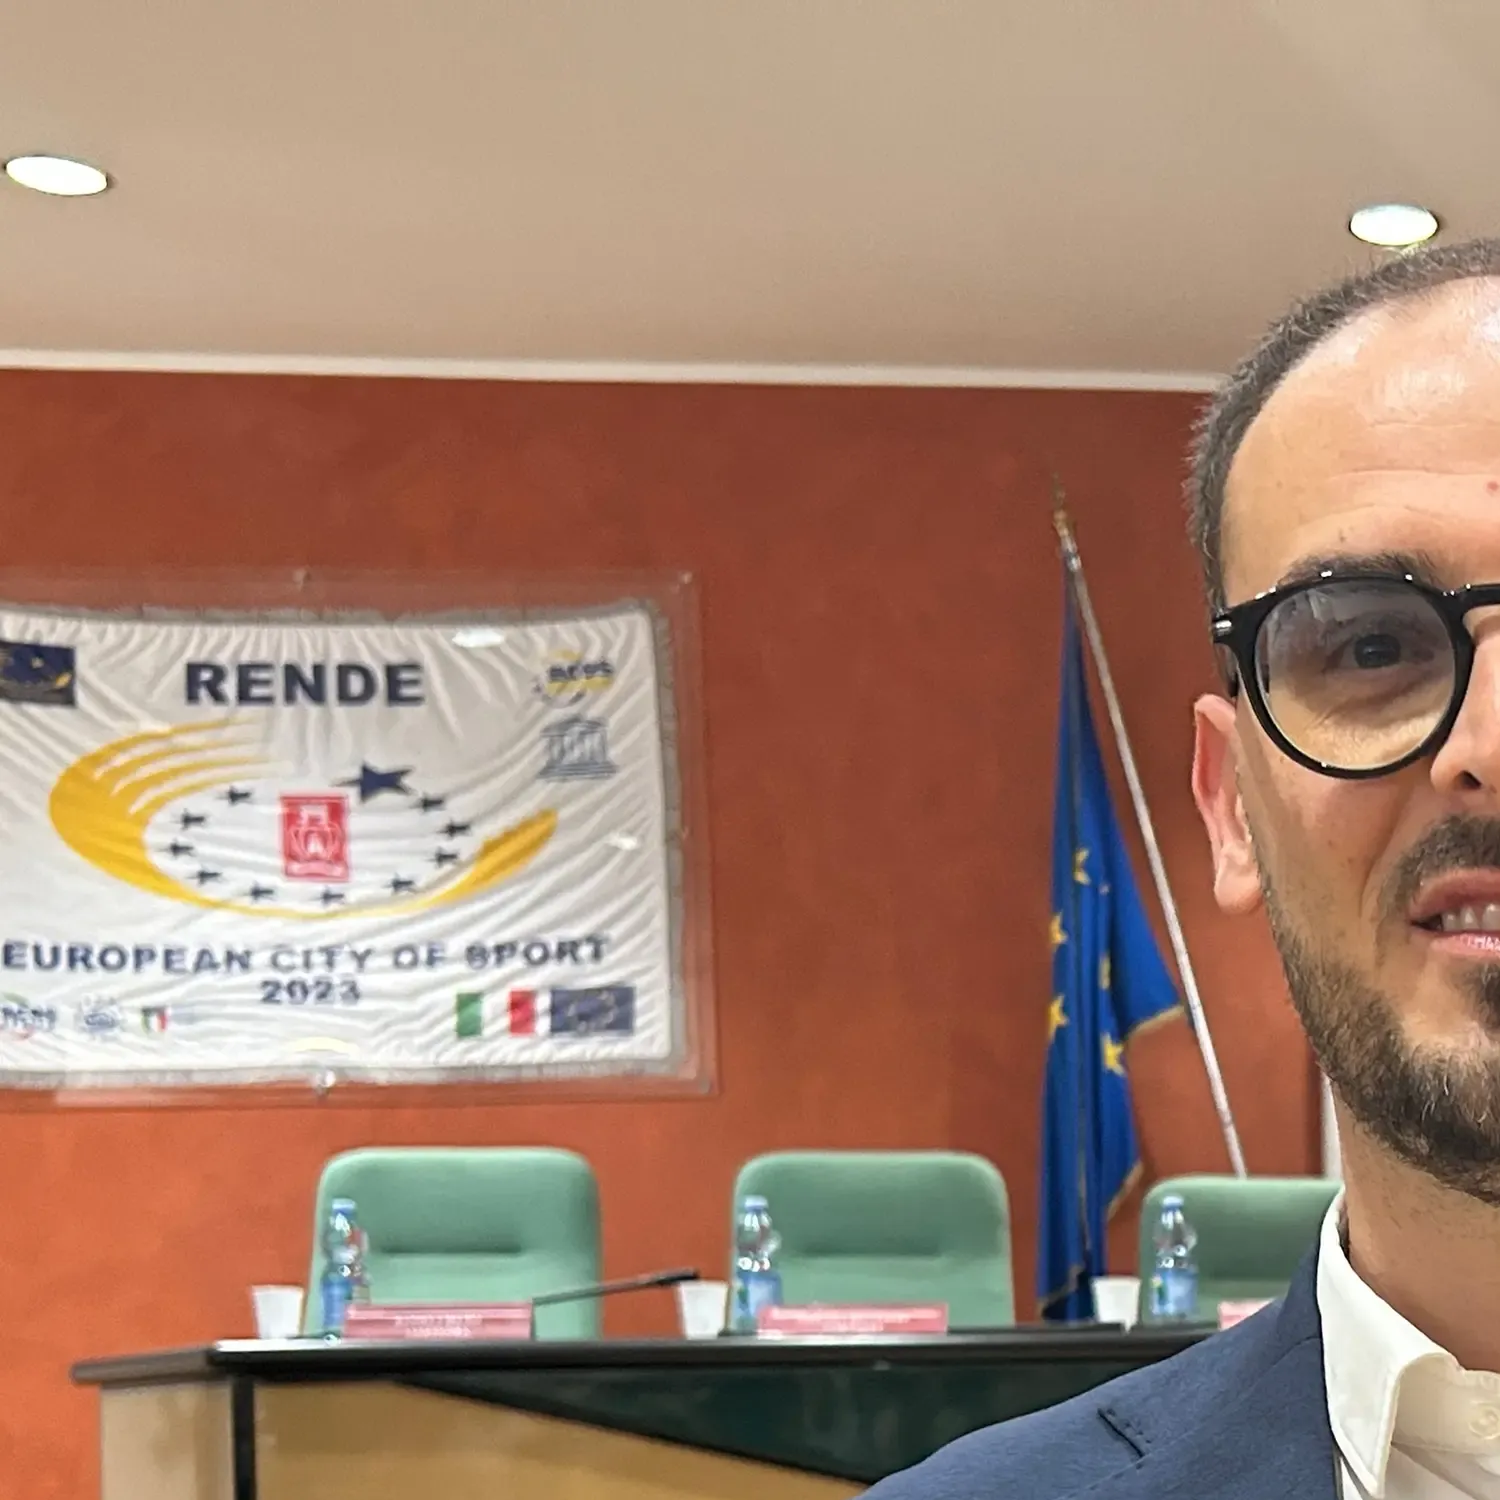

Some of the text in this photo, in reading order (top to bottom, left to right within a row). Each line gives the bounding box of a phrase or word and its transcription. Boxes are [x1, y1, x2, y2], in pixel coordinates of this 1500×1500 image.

[185, 662, 426, 705] RENDE
[3, 934, 606, 972] EUROPEAN CITY OF SPORT
[260, 978, 361, 1004] 2023
